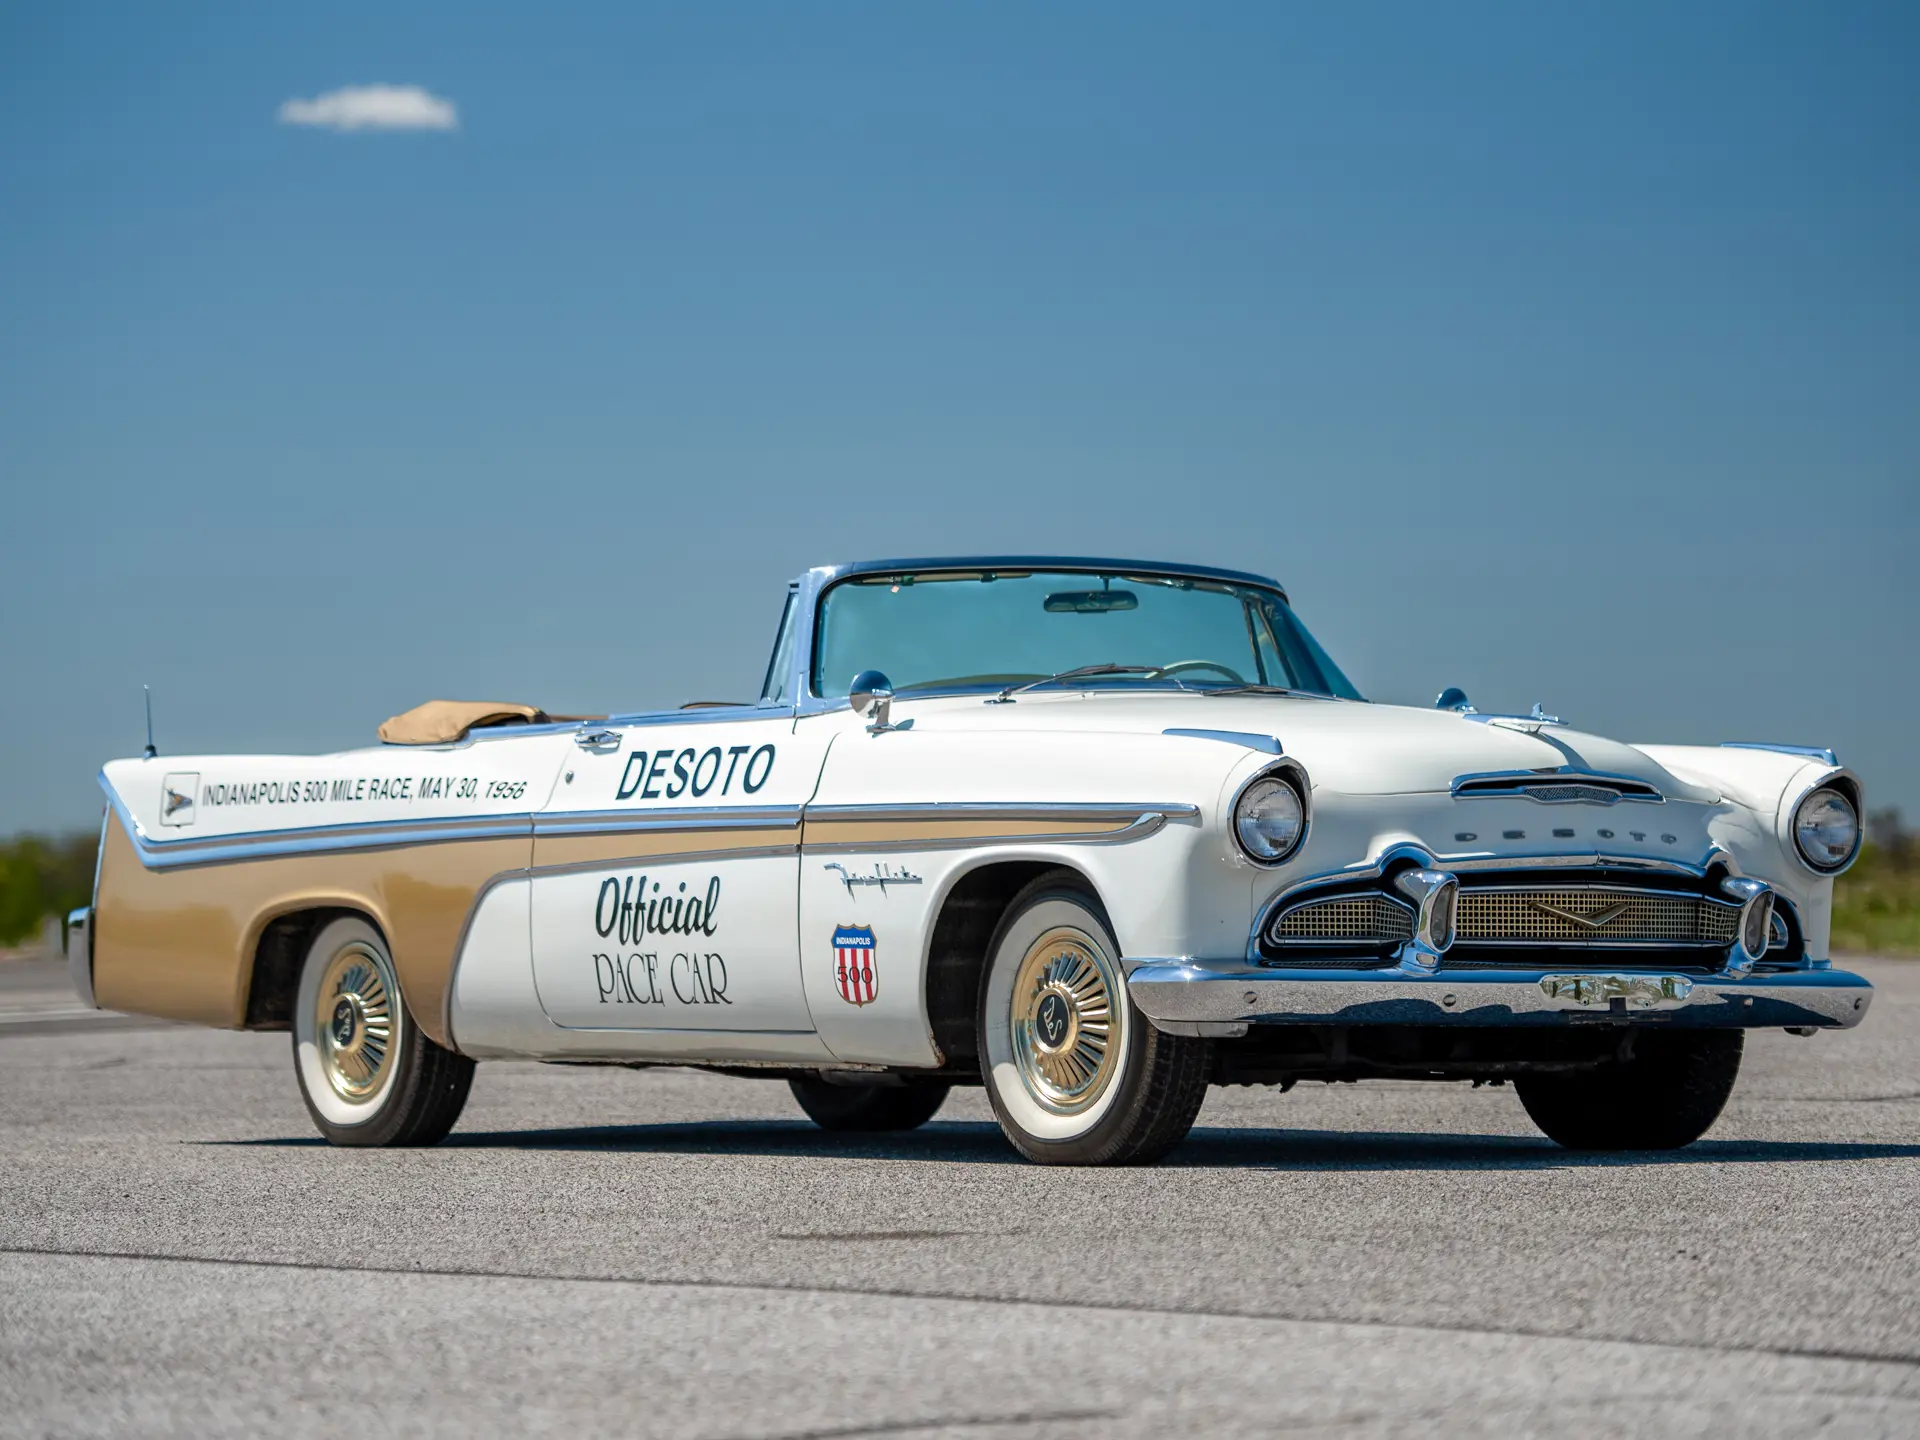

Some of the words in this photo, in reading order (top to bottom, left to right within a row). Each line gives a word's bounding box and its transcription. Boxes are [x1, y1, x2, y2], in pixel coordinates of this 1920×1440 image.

[202, 780, 302, 807] INDIANAPOLIS
[303, 780, 328, 803] 500
[330, 779, 367, 801] MILE
[368, 777, 413, 804] RACE,
[417, 777, 456, 800] MAY
[456, 777, 479, 803] 30,
[485, 780, 528, 800] 1956
[615, 743, 776, 800] DESOTO
[595, 875, 720, 946] Official
[836, 936, 871, 946] INDIANAPOLIS
[592, 951, 665, 1007] PACE
[670, 952, 733, 1005] CAR
[837, 965, 873, 985] 500
